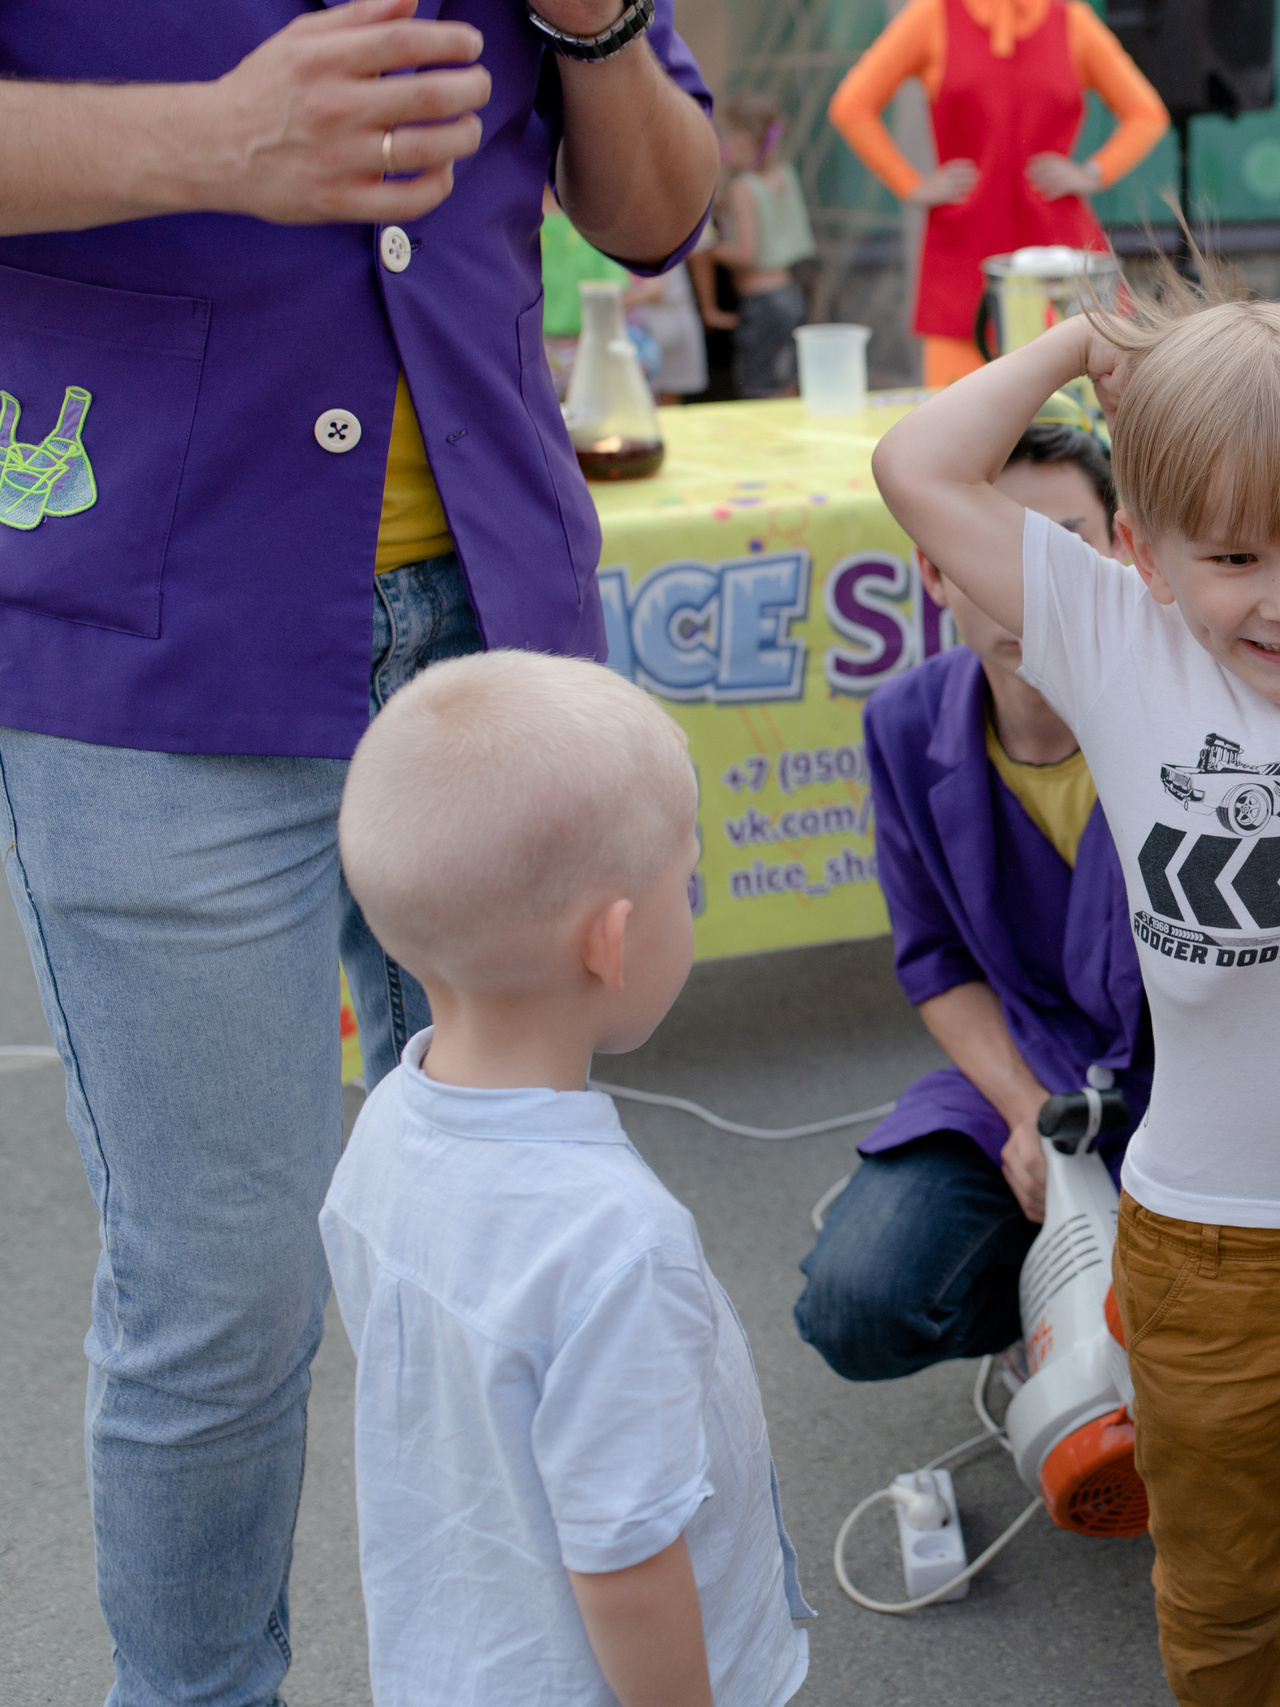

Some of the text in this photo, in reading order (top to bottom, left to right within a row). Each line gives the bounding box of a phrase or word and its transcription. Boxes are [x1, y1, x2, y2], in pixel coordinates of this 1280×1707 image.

[722, 743, 870, 795] +7 (950)
[724, 792, 872, 846] vk.com/
[1133, 915, 1208, 964] RODGER
